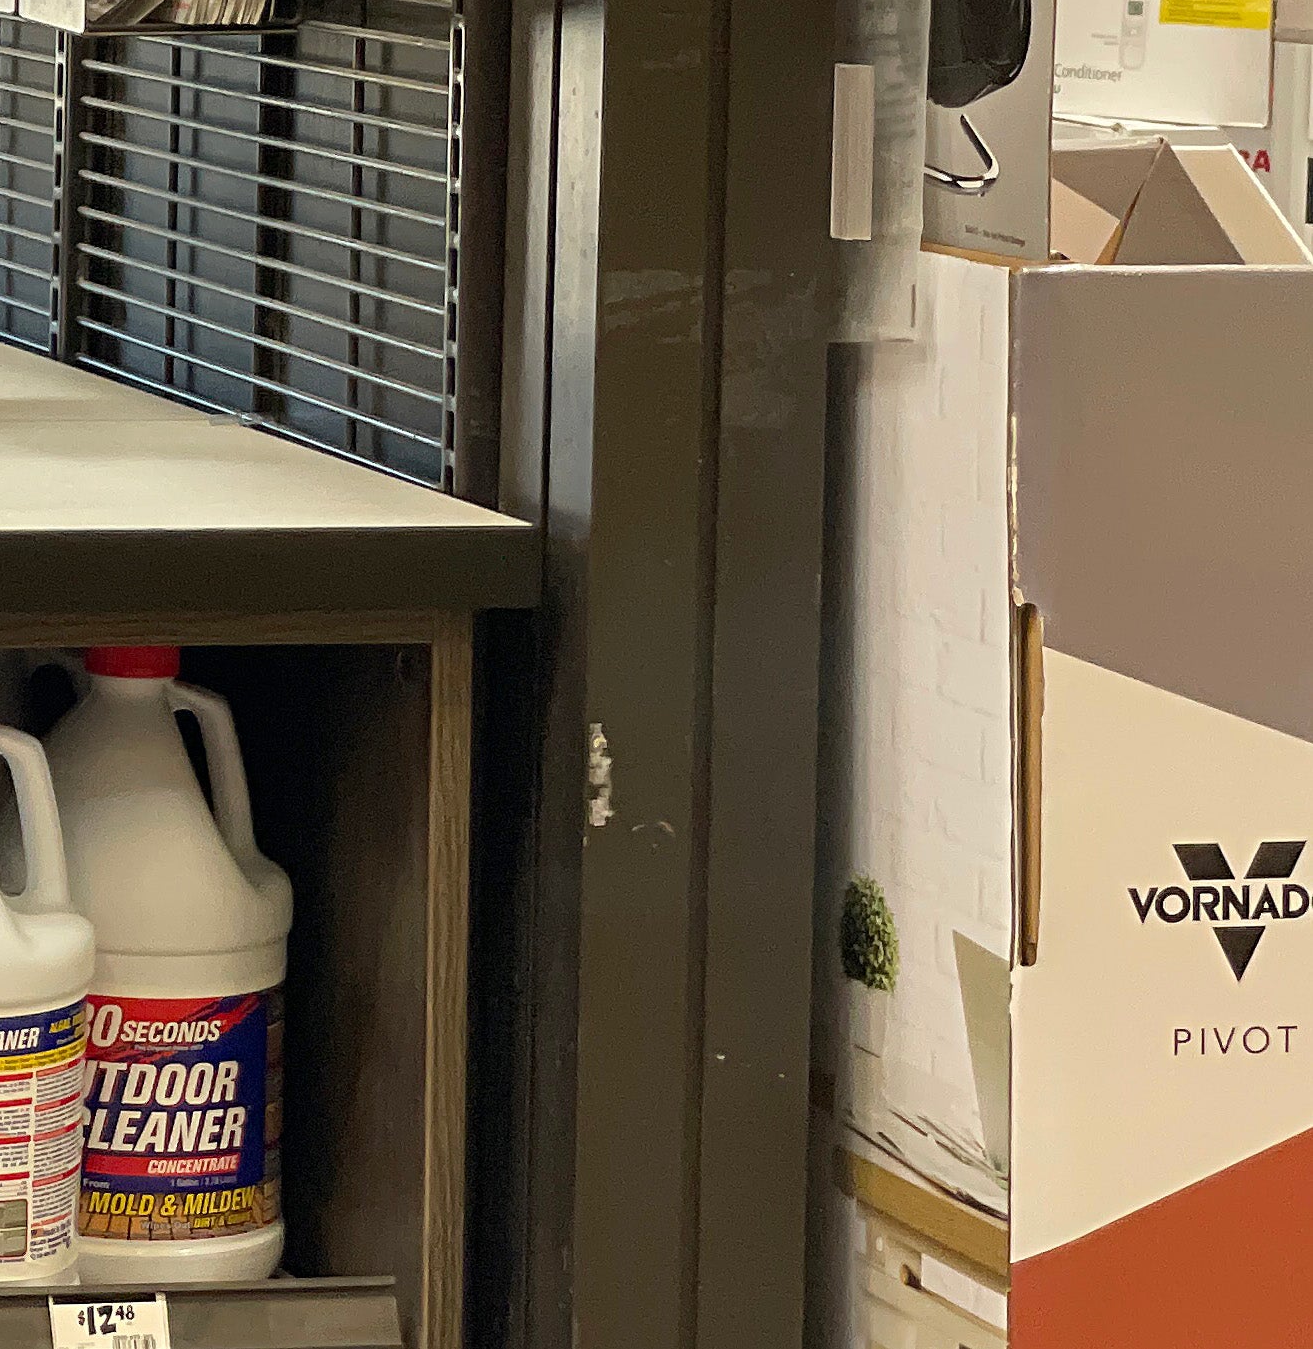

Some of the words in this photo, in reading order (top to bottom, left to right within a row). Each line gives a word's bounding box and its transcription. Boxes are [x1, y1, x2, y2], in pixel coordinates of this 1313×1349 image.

[1054, 64, 1122, 81] Conditioner
[1128, 885, 1313, 924] VORNAD
[121, 1021, 221, 1043] SECONDS
[1174, 1025, 1298, 1056] PIVOT
[148, 1155, 237, 1174] CONCENTRATE
[89, 1192, 154, 1215] MOLD
[184, 1186, 256, 1215] MILDEW
